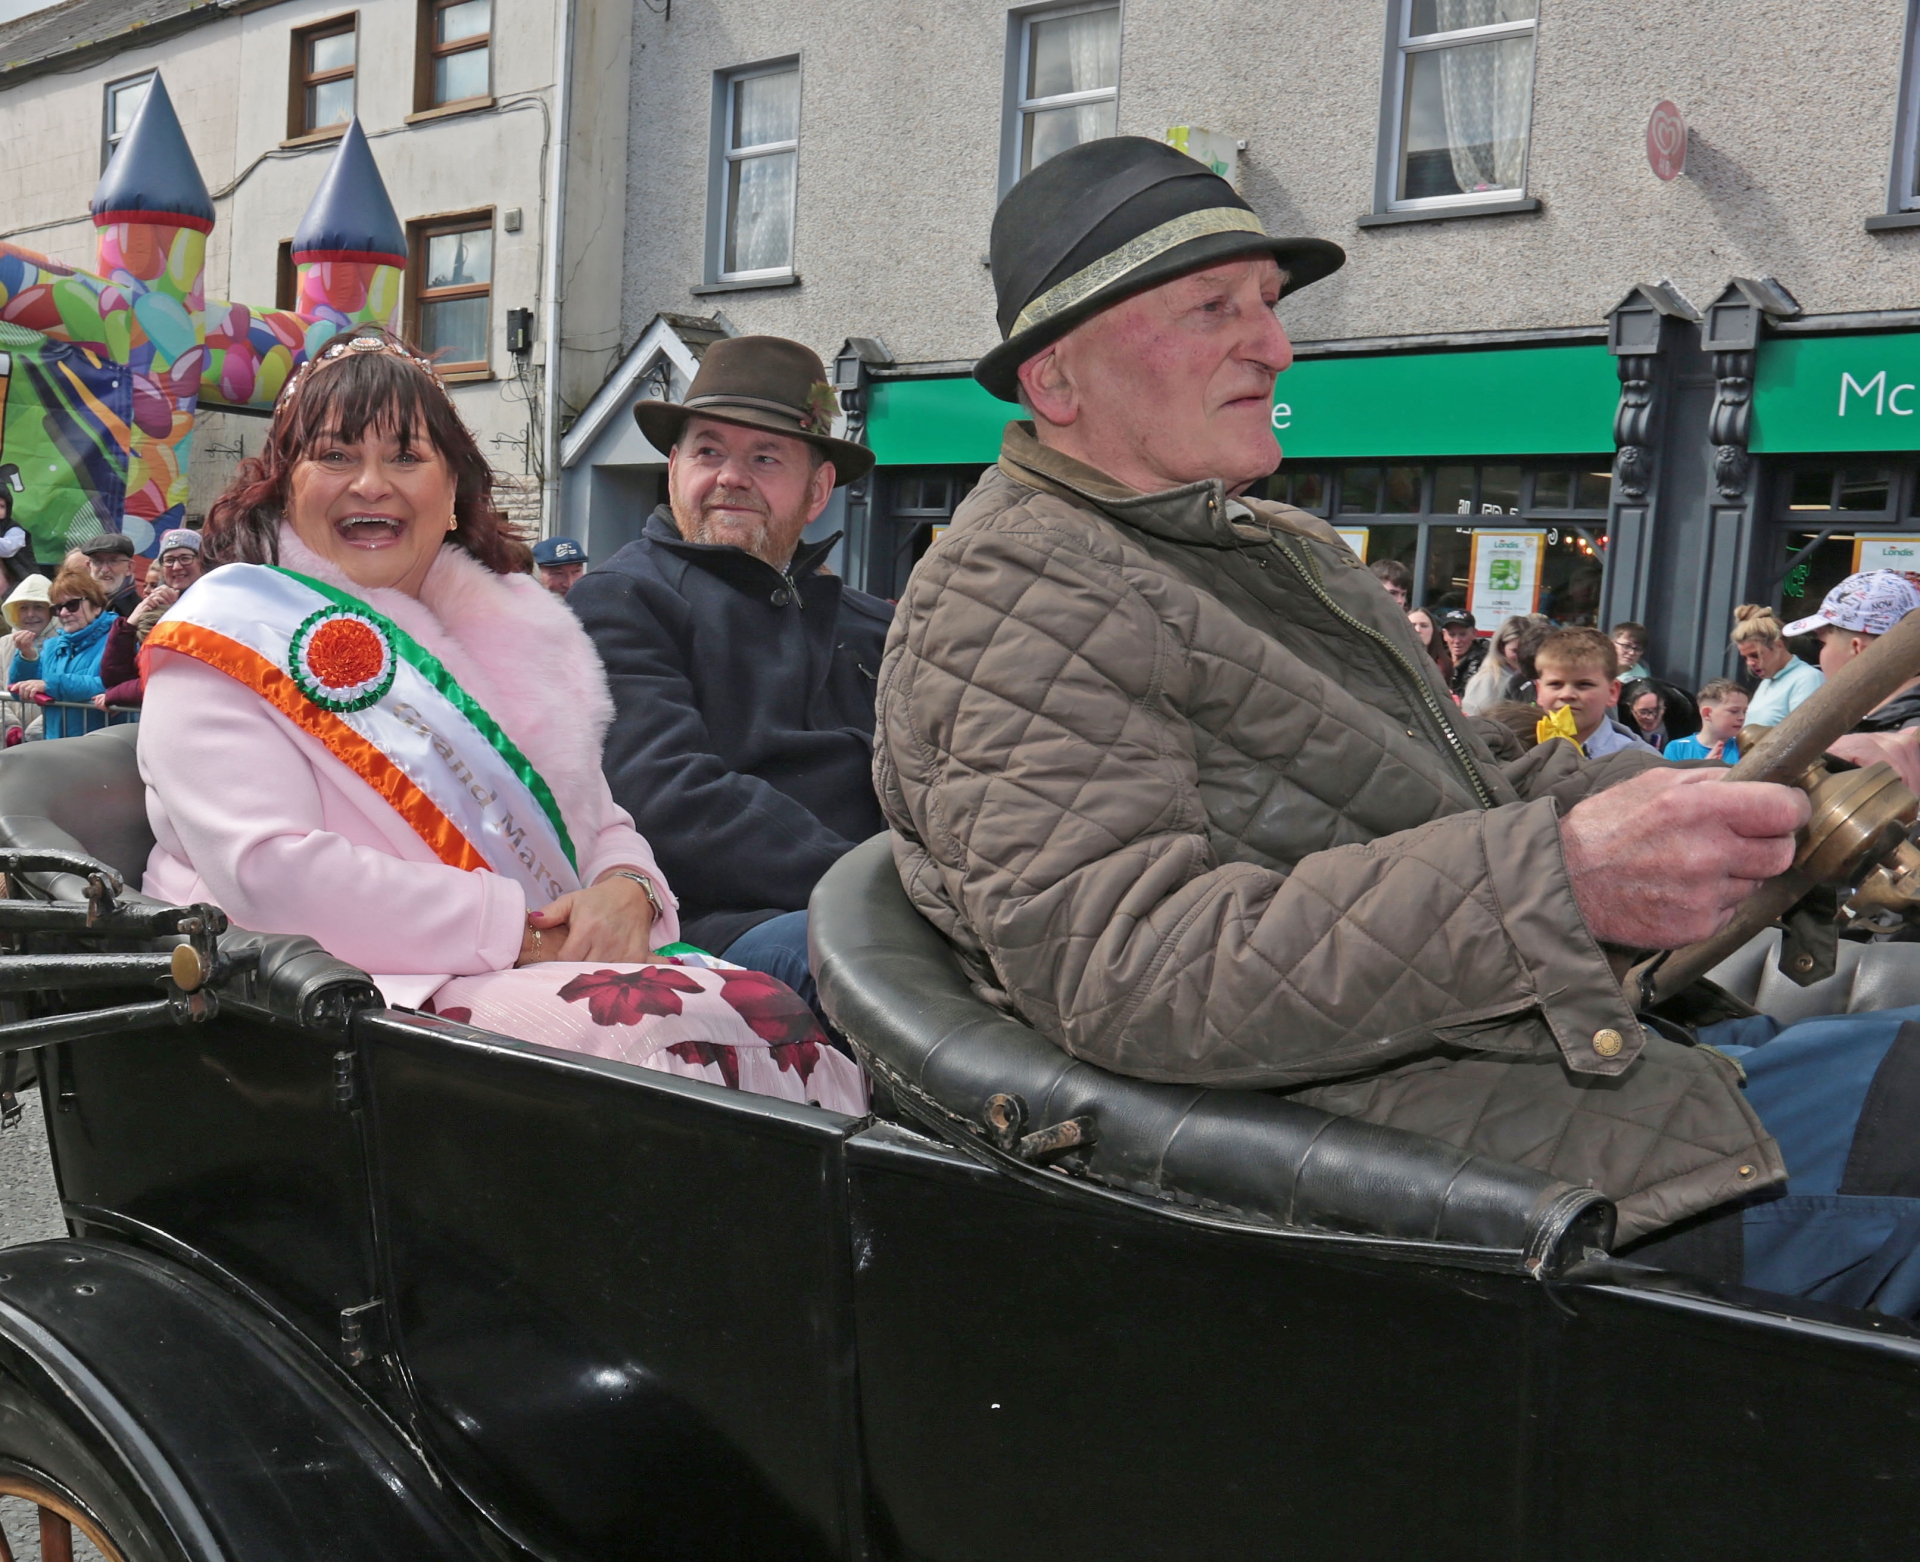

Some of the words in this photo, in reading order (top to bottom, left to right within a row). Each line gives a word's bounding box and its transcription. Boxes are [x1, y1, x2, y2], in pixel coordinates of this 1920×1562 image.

[1494, 541, 1519, 549] Londis
[1882, 548, 1914, 557] Londis
[393, 702, 498, 810] Grand
